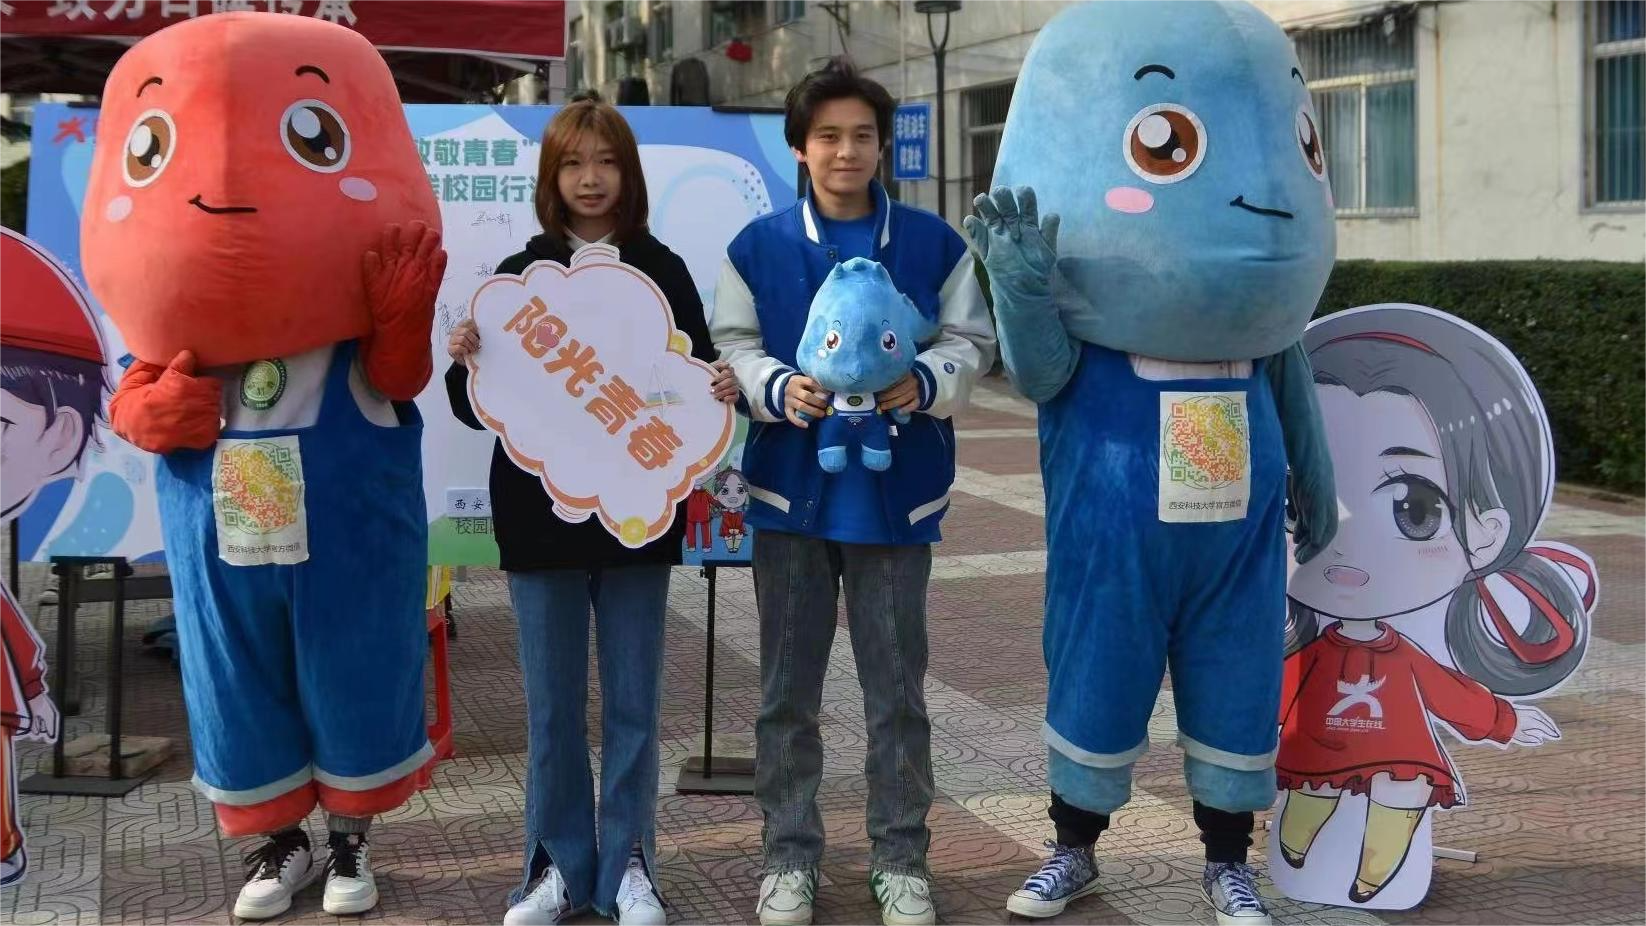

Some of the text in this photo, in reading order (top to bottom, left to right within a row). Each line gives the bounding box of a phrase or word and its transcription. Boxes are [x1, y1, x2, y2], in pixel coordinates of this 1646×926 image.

[503, 295, 683, 471] 阳光青春
[455, 517, 494, 535] 校园
[1325, 716, 1386, 730] 中国大学生在线
